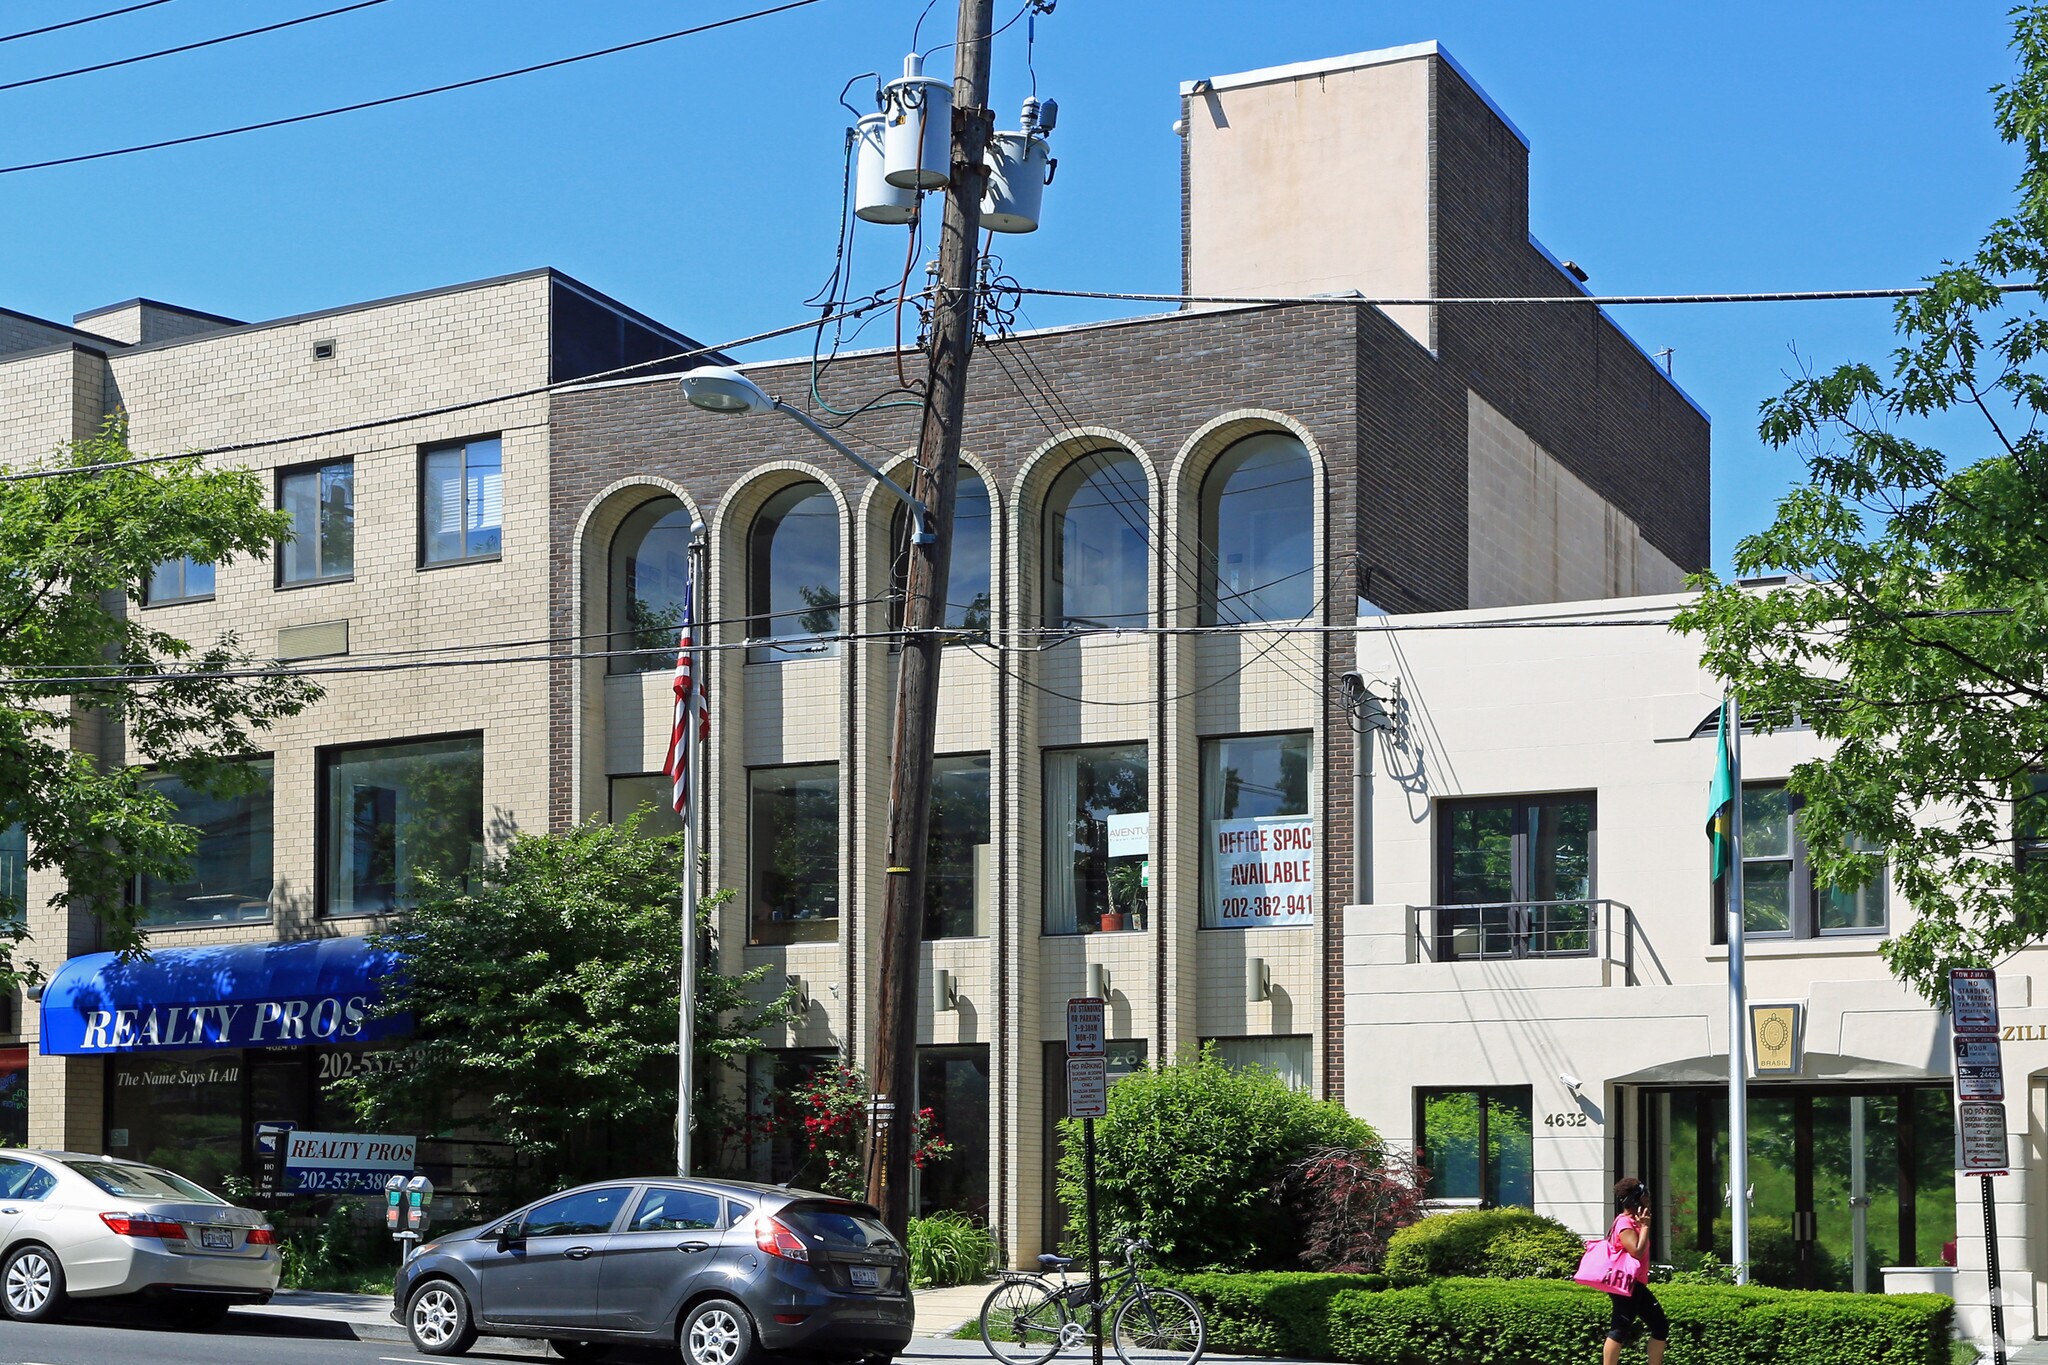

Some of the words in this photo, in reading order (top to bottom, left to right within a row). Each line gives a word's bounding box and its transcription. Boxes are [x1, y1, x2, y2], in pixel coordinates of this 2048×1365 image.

[1219, 829, 1268, 854] OFFICE
[1273, 827, 1312, 852] SPAC
[1231, 860, 1310, 886] AVAILABLE
[1222, 894, 1313, 919] 202-362-941
[1070, 1005, 1077, 1013] NO
[1078, 1004, 1101, 1013] STANDING
[80, 1003, 243, 1049] REALTY
[249, 996, 368, 1042] PROS
[1071, 1014, 1078, 1023] OR
[1079, 1014, 1101, 1023] PARKING
[1959, 1044, 1966, 1056] 2
[1081, 1062, 1102, 1070] PARKING
[117, 1072, 137, 1087] The
[142, 1070, 176, 1086] Name
[178, 1069, 204, 1086] Says
[208, 1068, 218, 1083] It
[219, 1067, 238, 1083] All
[1544, 1113, 1587, 1127] 4632
[1974, 1108, 2001, 1116] PARKING
[291, 1140, 365, 1161] REALTY
[366, 1143, 413, 1162] PROS
[298, 1171, 390, 1190] 202-537-380
